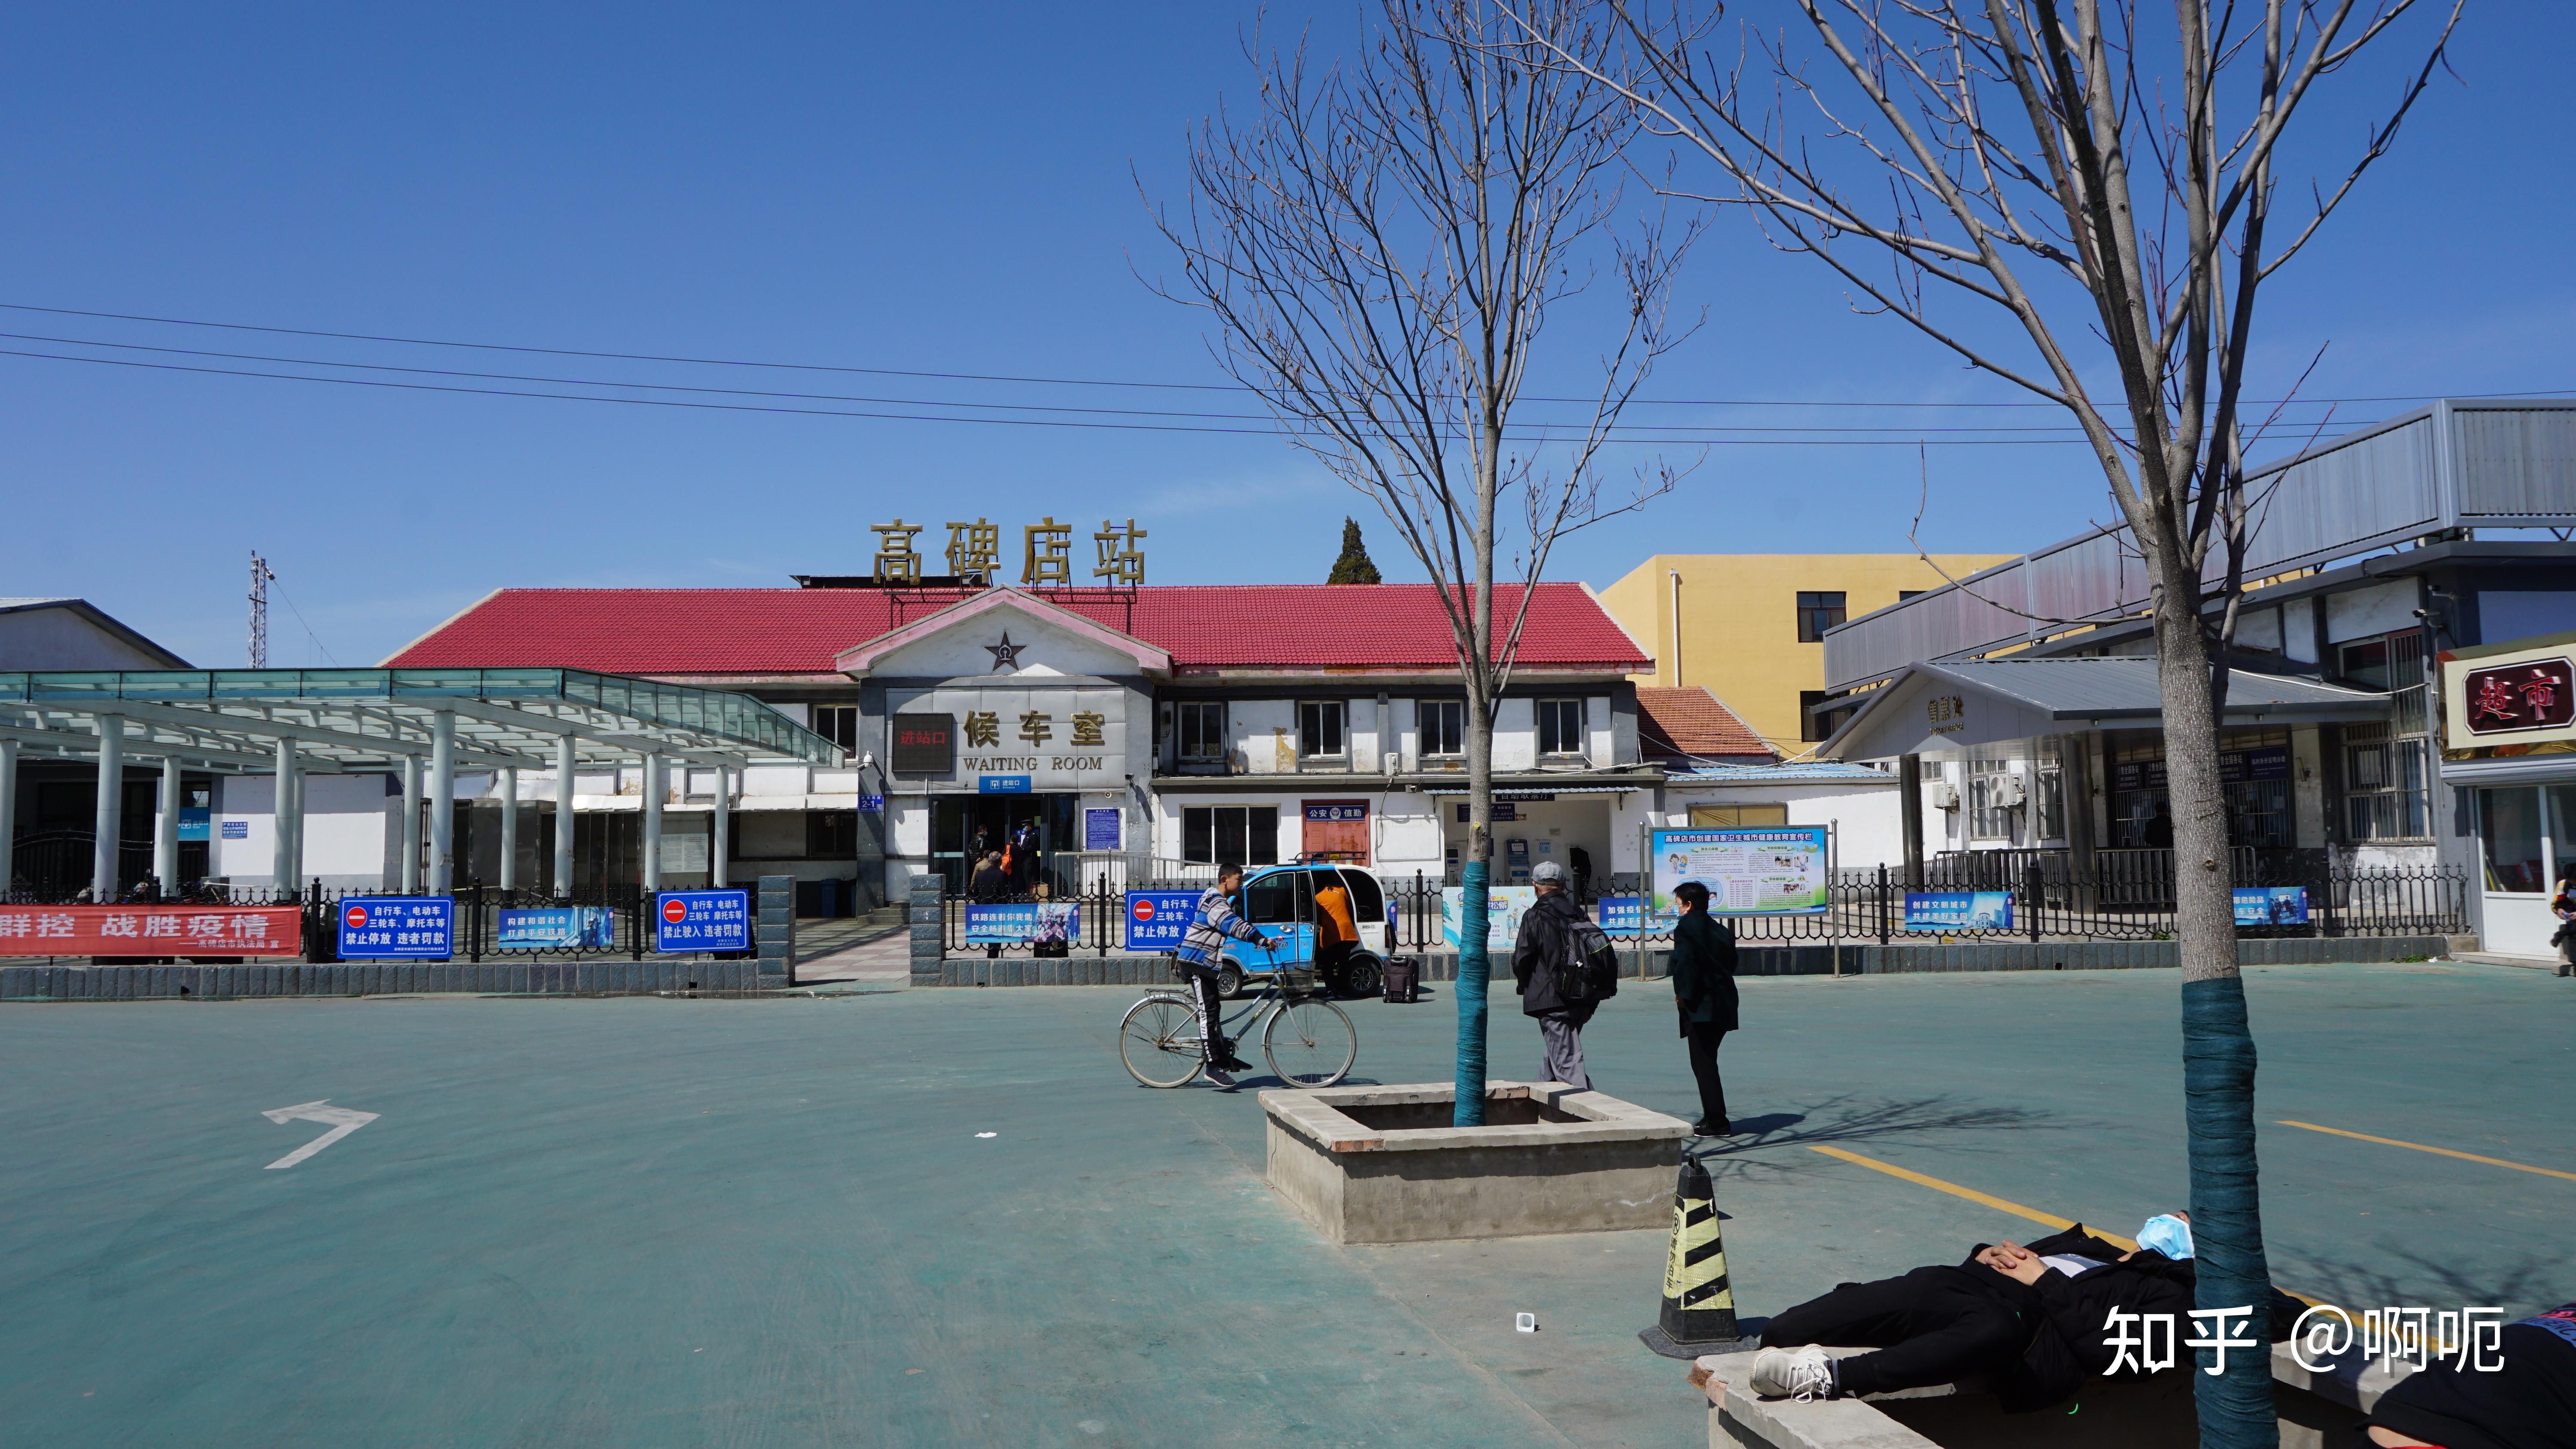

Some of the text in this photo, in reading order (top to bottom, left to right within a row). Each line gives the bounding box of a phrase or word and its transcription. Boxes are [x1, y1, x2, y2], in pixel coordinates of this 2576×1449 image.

[870, 516, 1147, 585] 高碑店站
[2474, 669, 2561, 721] 超市
[963, 709, 1105, 748] 候车室
[900, 731, 945, 745] 进站口
[963, 757, 1103, 771] WAITING ROOM
[1309, 809, 1361, 817] 公安 值勤
[1665, 833, 1812, 843] 高碑店市创建国家卫生城市健康教育宣传栏
[693, 900, 738, 910] 自行车 电动车
[507, 916, 566, 926] 构建和谐社会
[689, 910, 742, 921] 三轮车 摩托车等
[971, 913, 1033, 922] 铁路连着你我他
[0, 913, 269, 938] 群控 战胜疫情
[368, 918, 445, 928] 三轮车、摩托车等
[971, 925, 1033, 933] 安全畅通靠大家
[507, 928, 566, 938] 打造平安铁路
[663, 924, 742, 939] 禁止驶入 违者罚款
[1133, 925, 1179, 938] 禁止停放
[270, 939, 279, 948] 宣
[346, 932, 445, 945] 禁止停放 违者罚款
[1666, 1236, 1678, 1290] 请勿泊车
